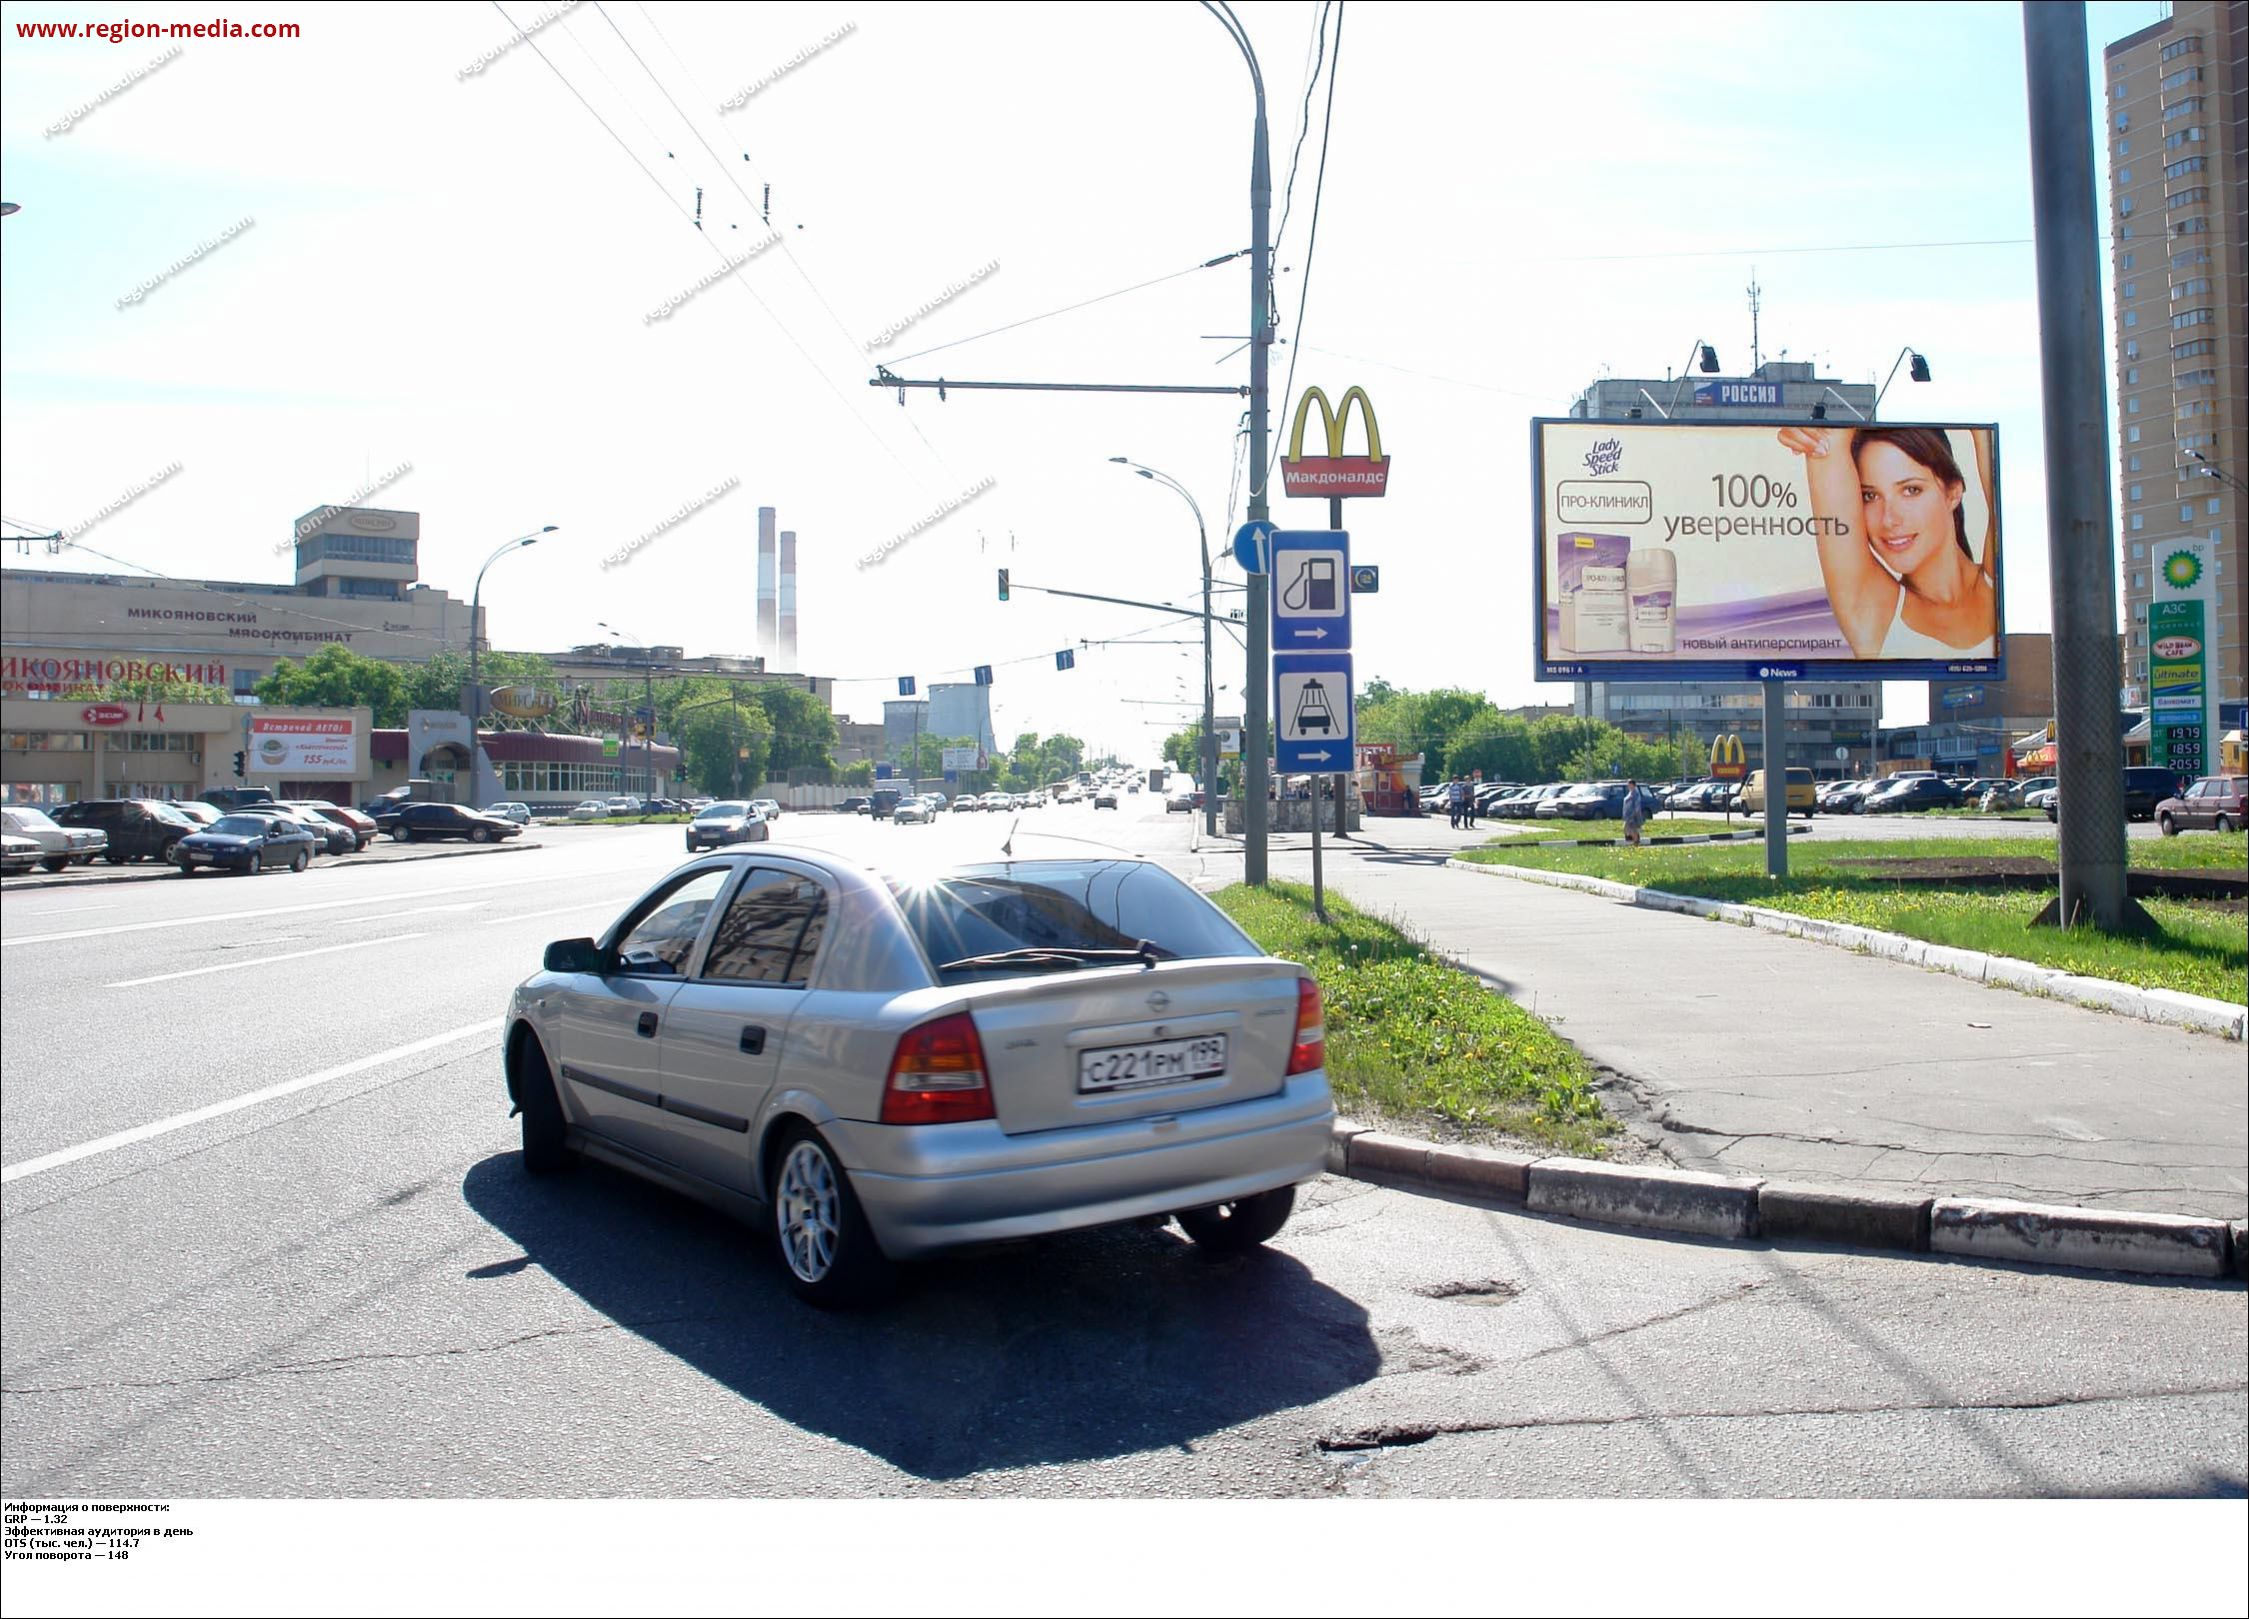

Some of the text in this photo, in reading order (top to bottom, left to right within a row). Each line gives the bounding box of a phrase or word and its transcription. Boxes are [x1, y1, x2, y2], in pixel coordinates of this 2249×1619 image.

[1721, 384, 1776, 403] РОССИЯ
[1592, 438, 1620, 454] Lady
[1582, 447, 1623, 468] Speed
[1589, 461, 1619, 477] Stick
[1286, 471, 1385, 485] Макдоналдс
[1711, 473, 1798, 508] 100%
[1561, 495, 1649, 508] ПРО-КЛИНИКЛ
[1663, 515, 1850, 542] уверенность
[2192, 543, 2205, 552] bp
[127, 606, 257, 624] МИКОЯНОВСКИЙ
[2162, 603, 2187, 615] АЗС
[1682, 636, 1842, 652] новый антиперспирант
[1770, 668, 1798, 678] News
[263, 722, 344, 733] Встречай ЛЕТО!
[303, 754, 323, 764] 155
[1187, 1039, 1221, 1063] 199
